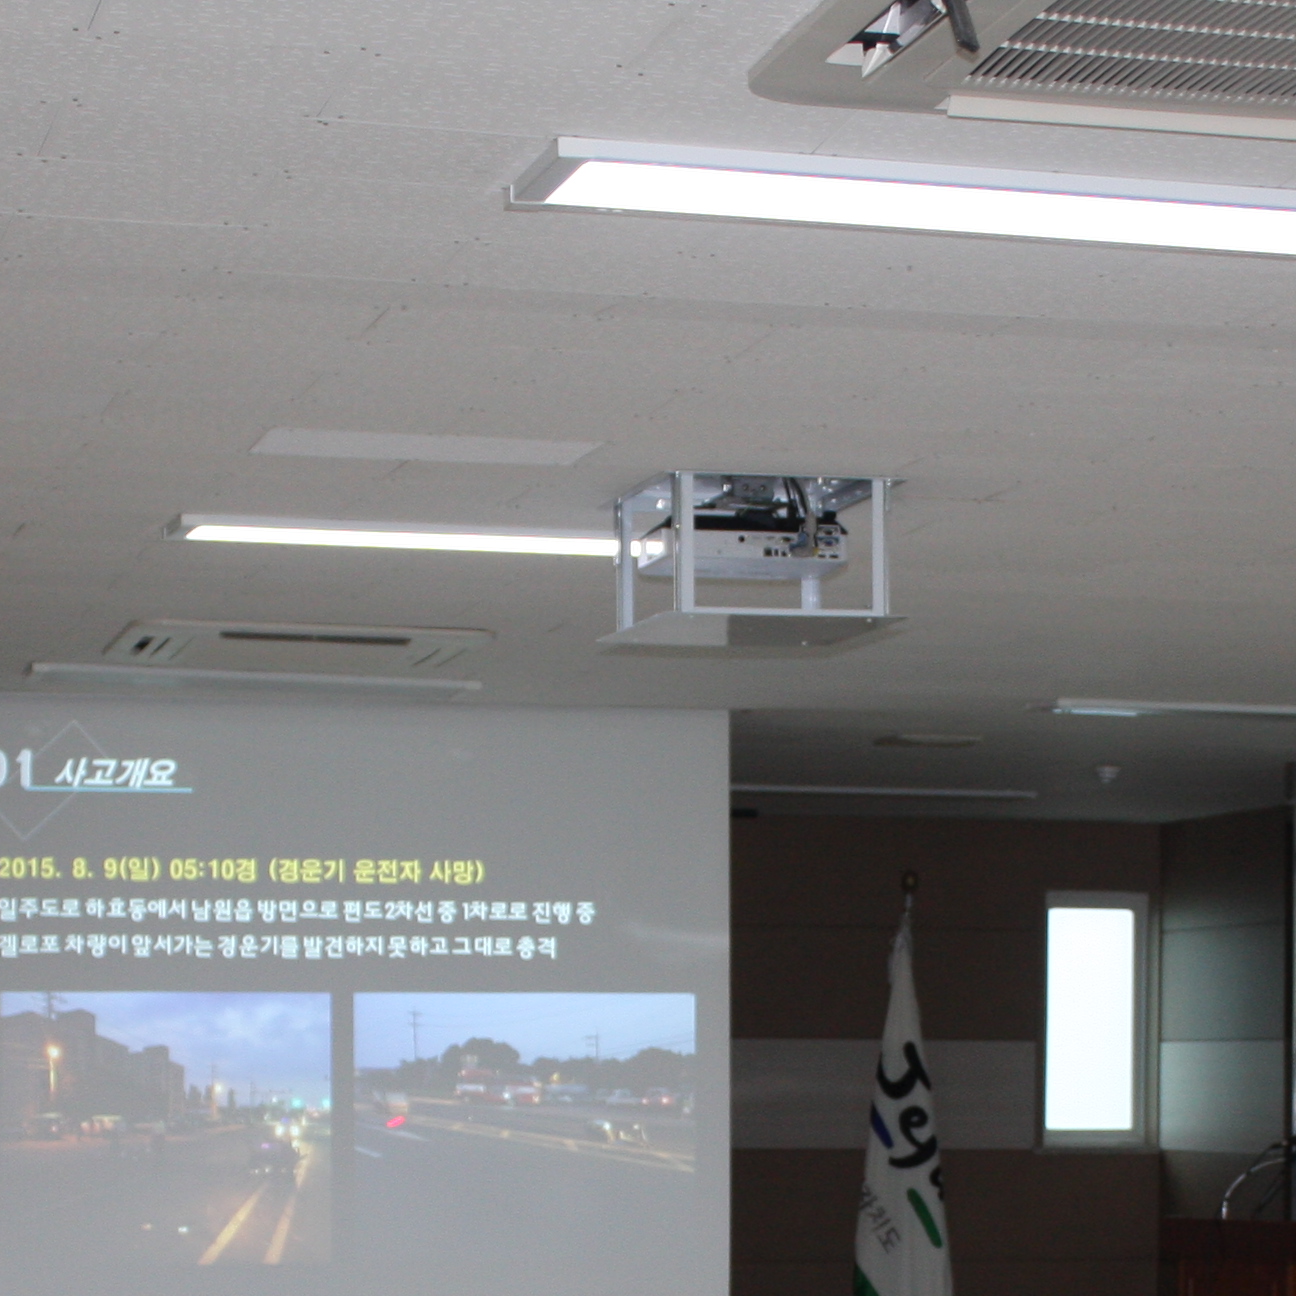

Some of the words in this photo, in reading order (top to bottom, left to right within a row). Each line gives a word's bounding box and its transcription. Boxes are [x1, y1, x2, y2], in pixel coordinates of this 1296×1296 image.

[54, 756, 178, 787] 사고개요
[72, 857, 94, 880] 8.
[103, 857, 161, 882] 9(일)
[168, 858, 259, 884] 05:10경
[268, 858, 346, 885] (경운기
[353, 859, 422, 884] 운전자
[429, 860, 485, 886] 사망)
[84, 897, 188, 922] 하효동에서
[190, 898, 255, 922] 남원읍
[257, 899, 340, 923] 방면으로
[436, 901, 458, 924] 중
[461, 900, 529, 923] 1차로로
[531, 900, 573, 925] 진행
[575, 901, 596, 925] 중
[64, 934, 128, 959] 차량이
[217, 935, 300, 960] 경운기를
[303, 935, 385, 960] 발견하지
[387, 935, 450, 959] 못하고
[452, 936, 514, 958] 그대로
[515, 936, 558, 961] 충격
